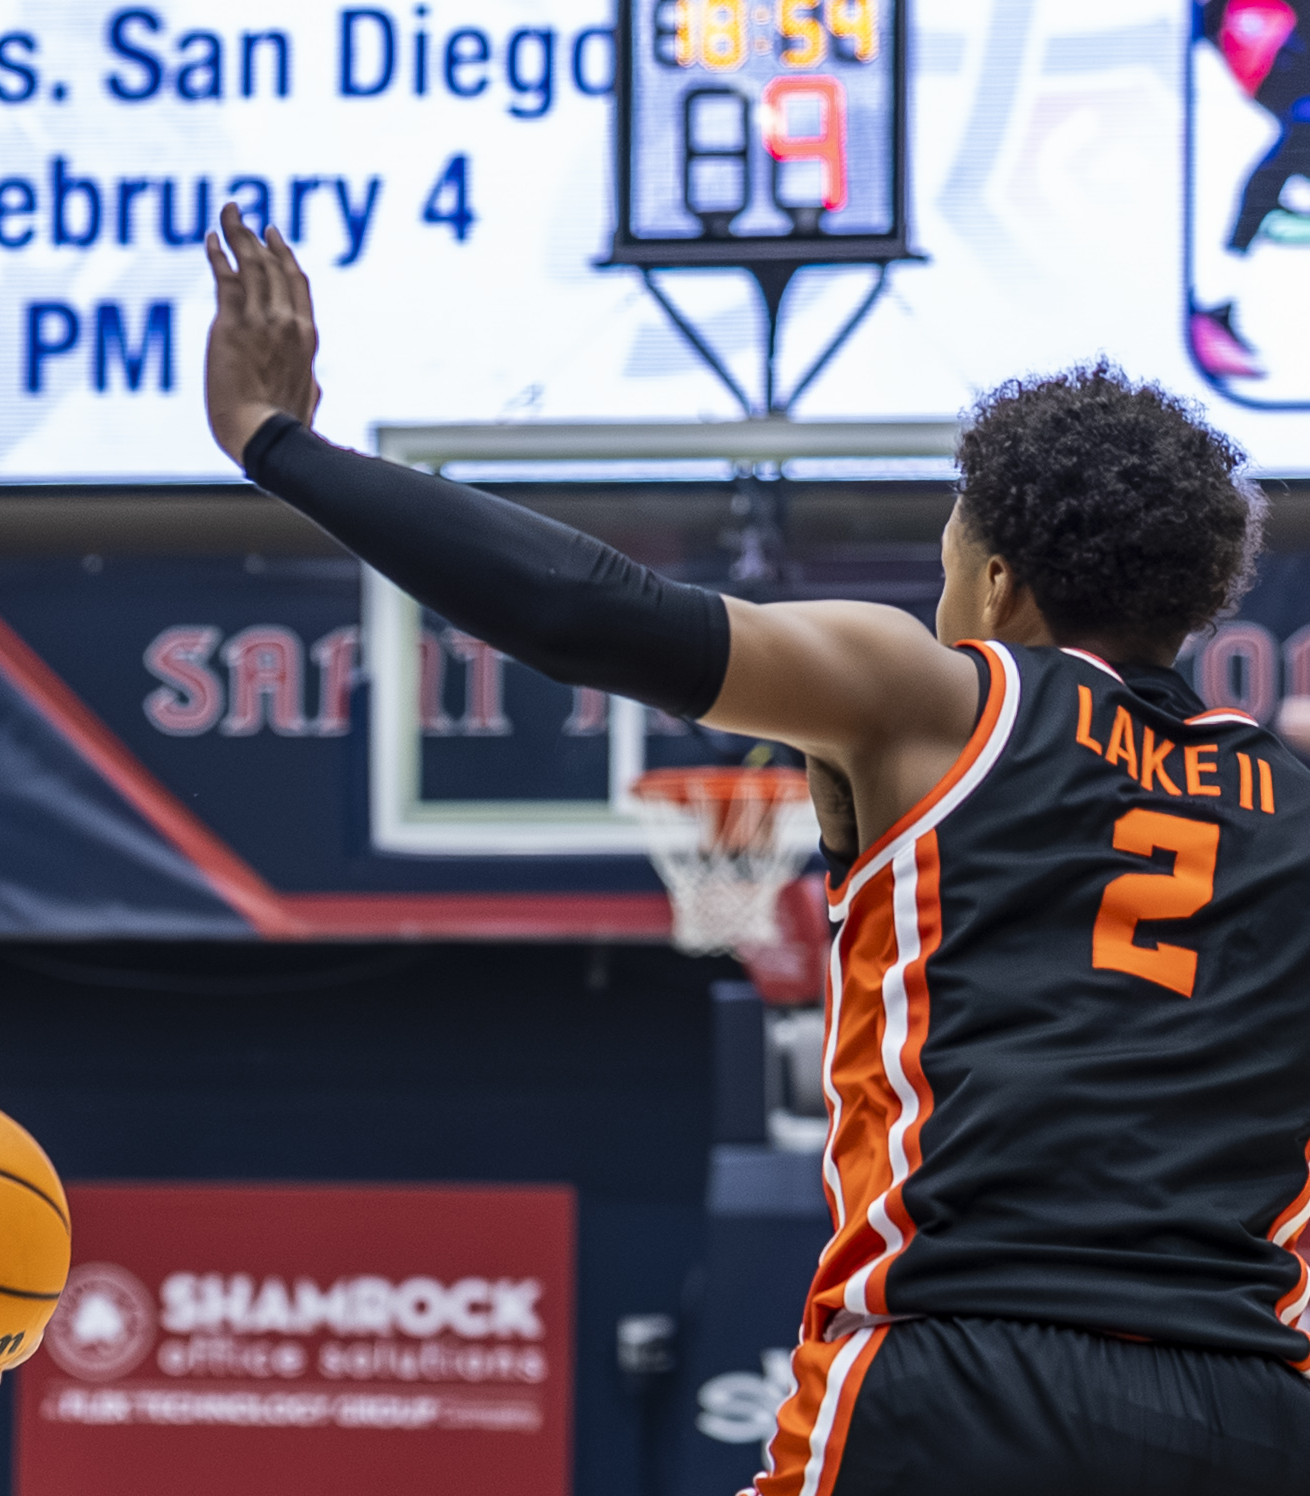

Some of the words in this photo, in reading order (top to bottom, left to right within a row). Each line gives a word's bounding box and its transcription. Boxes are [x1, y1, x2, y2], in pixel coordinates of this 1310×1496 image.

[106, 7, 293, 104] San
[338, 6, 617, 121] Diego
[421, 151, 476, 243] 4
[23, 299, 177, 394] PM
[1076, 684, 1222, 797] LAKE
[1091, 807, 1221, 999] 2
[159, 1270, 546, 1341] SHAMROCK
